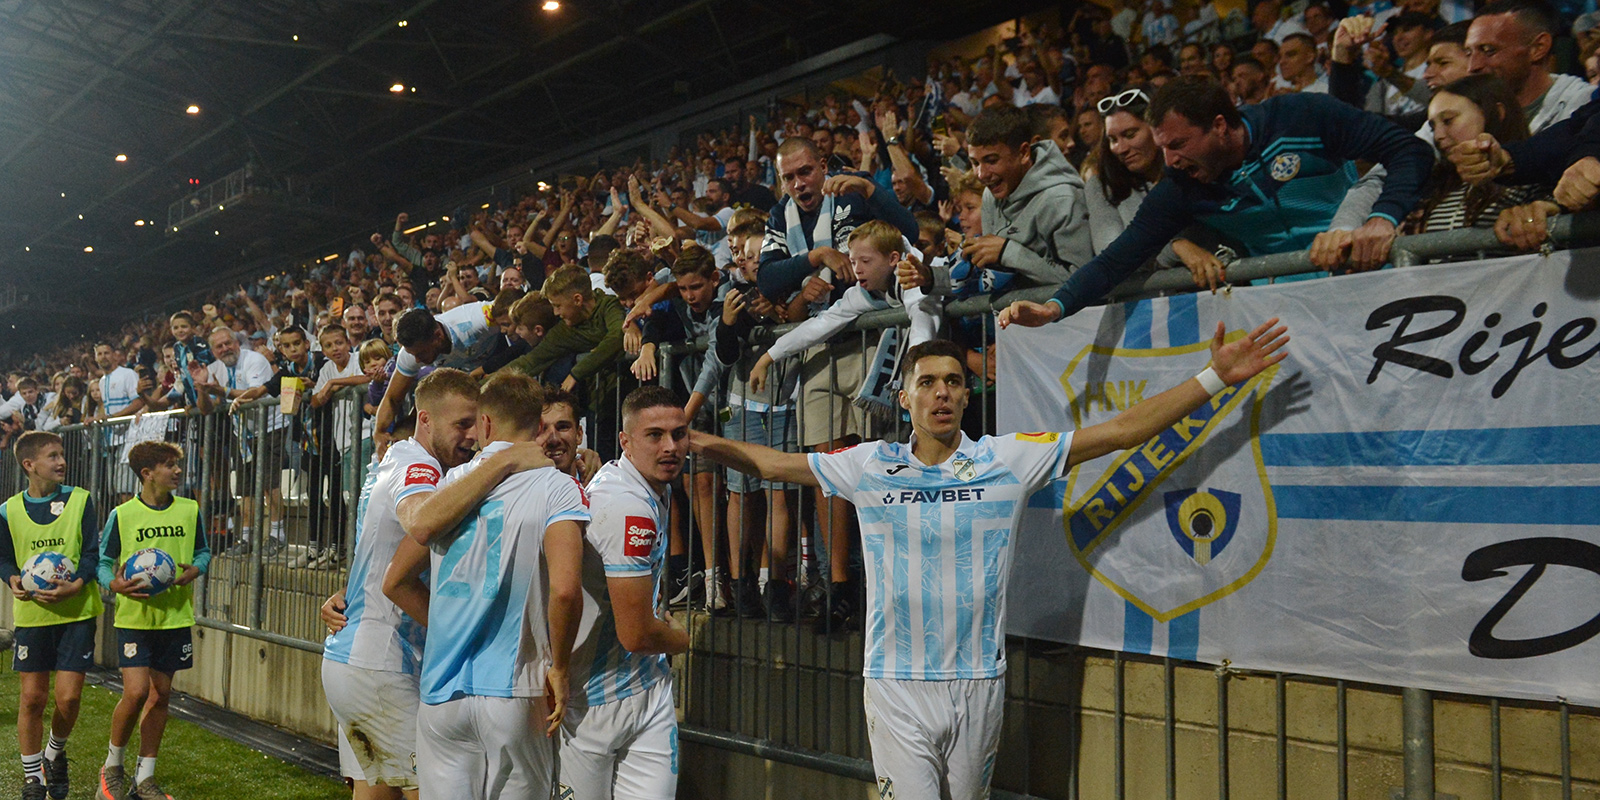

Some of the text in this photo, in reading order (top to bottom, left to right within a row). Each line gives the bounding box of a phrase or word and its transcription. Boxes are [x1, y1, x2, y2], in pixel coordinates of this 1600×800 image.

[1084, 379, 1148, 412] HNK
[900, 488, 985, 503] FAVBET
[136, 525, 186, 542] Joma
[31, 537, 65, 550] Joma
